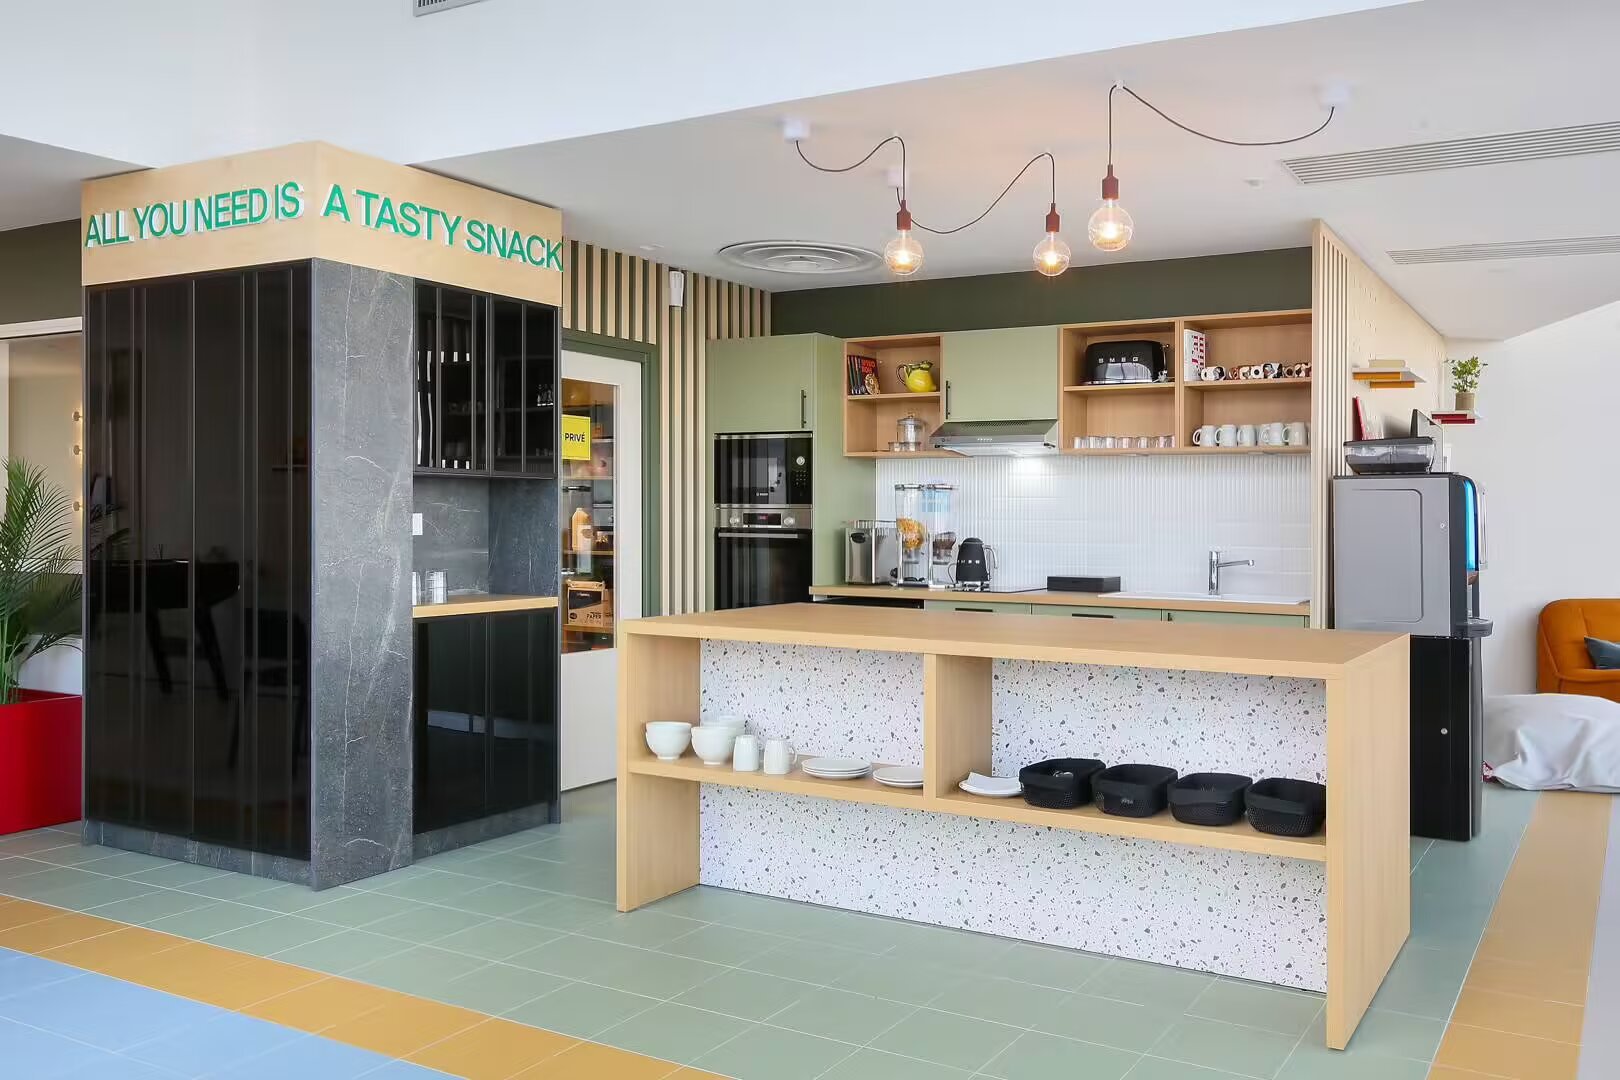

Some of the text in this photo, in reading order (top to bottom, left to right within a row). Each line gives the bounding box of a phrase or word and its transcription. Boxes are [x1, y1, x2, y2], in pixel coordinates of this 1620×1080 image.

[85, 181, 302, 247] ALL YOU NEED IS
[322, 183, 564, 272] A TASTY SNACK
[564, 432, 586, 442] PRIVÉ
